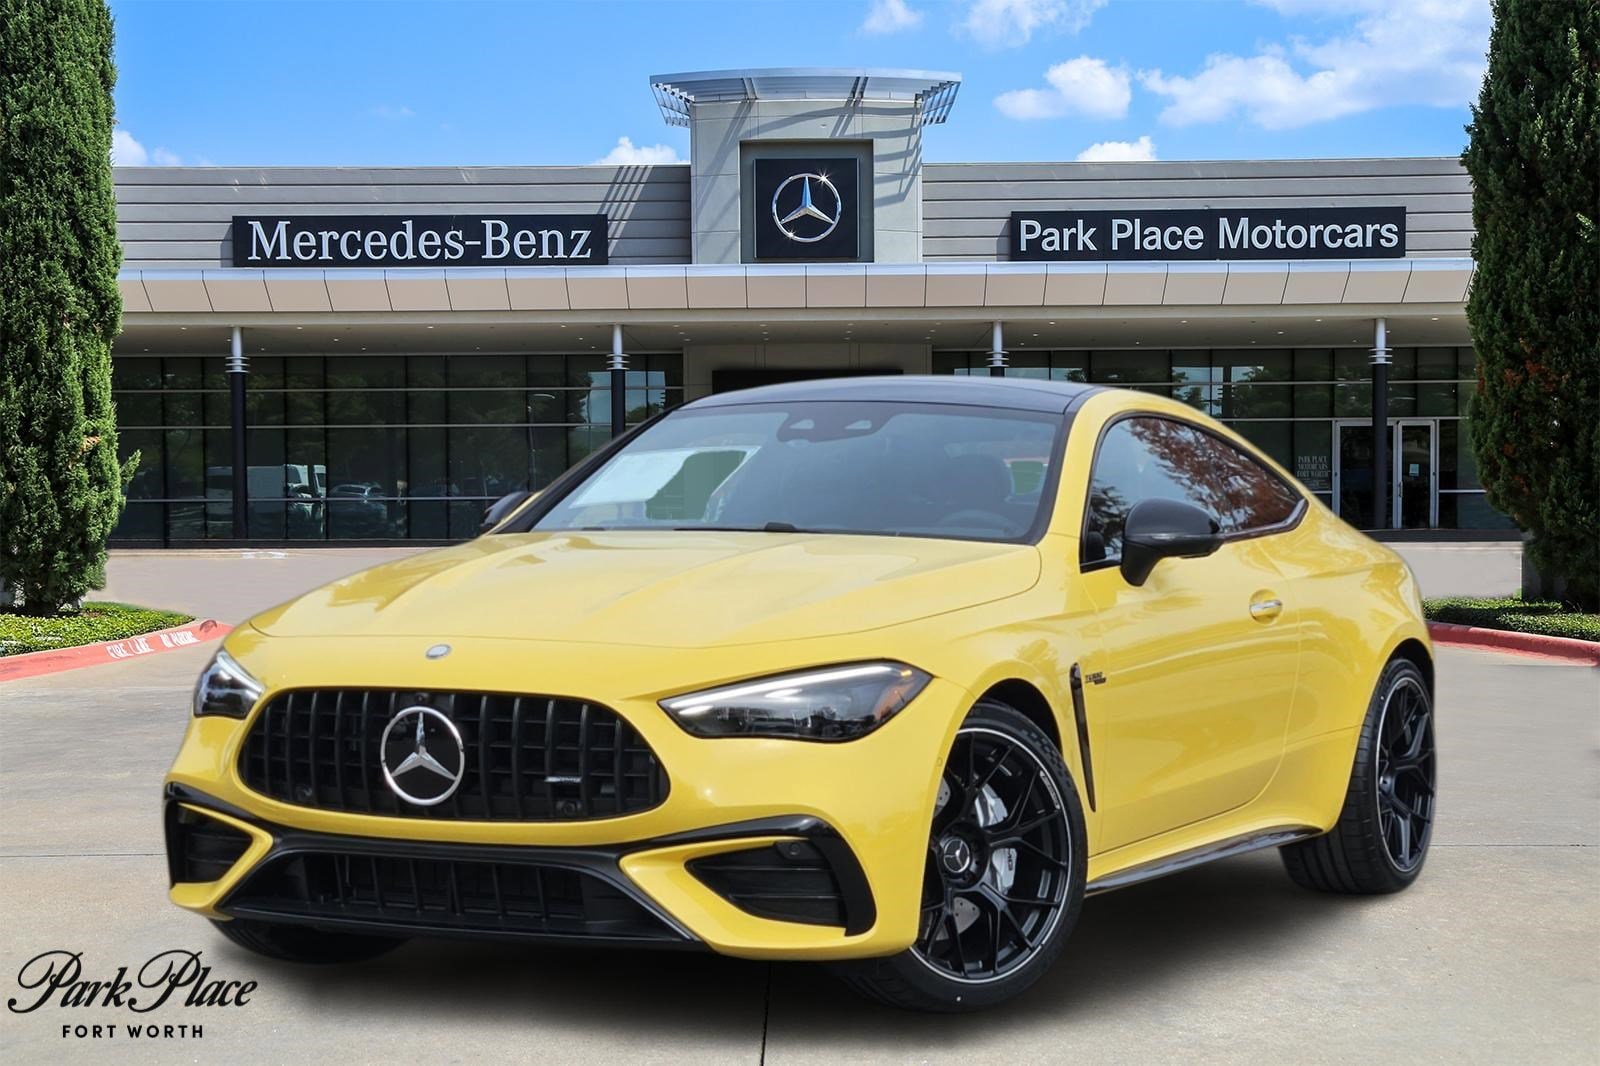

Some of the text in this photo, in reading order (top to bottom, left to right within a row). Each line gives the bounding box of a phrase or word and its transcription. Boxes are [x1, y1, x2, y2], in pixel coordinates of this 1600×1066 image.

[248, 219, 592, 261] Mercedes-Benz
[1019, 217, 1399, 252] Park Place Motorcars
